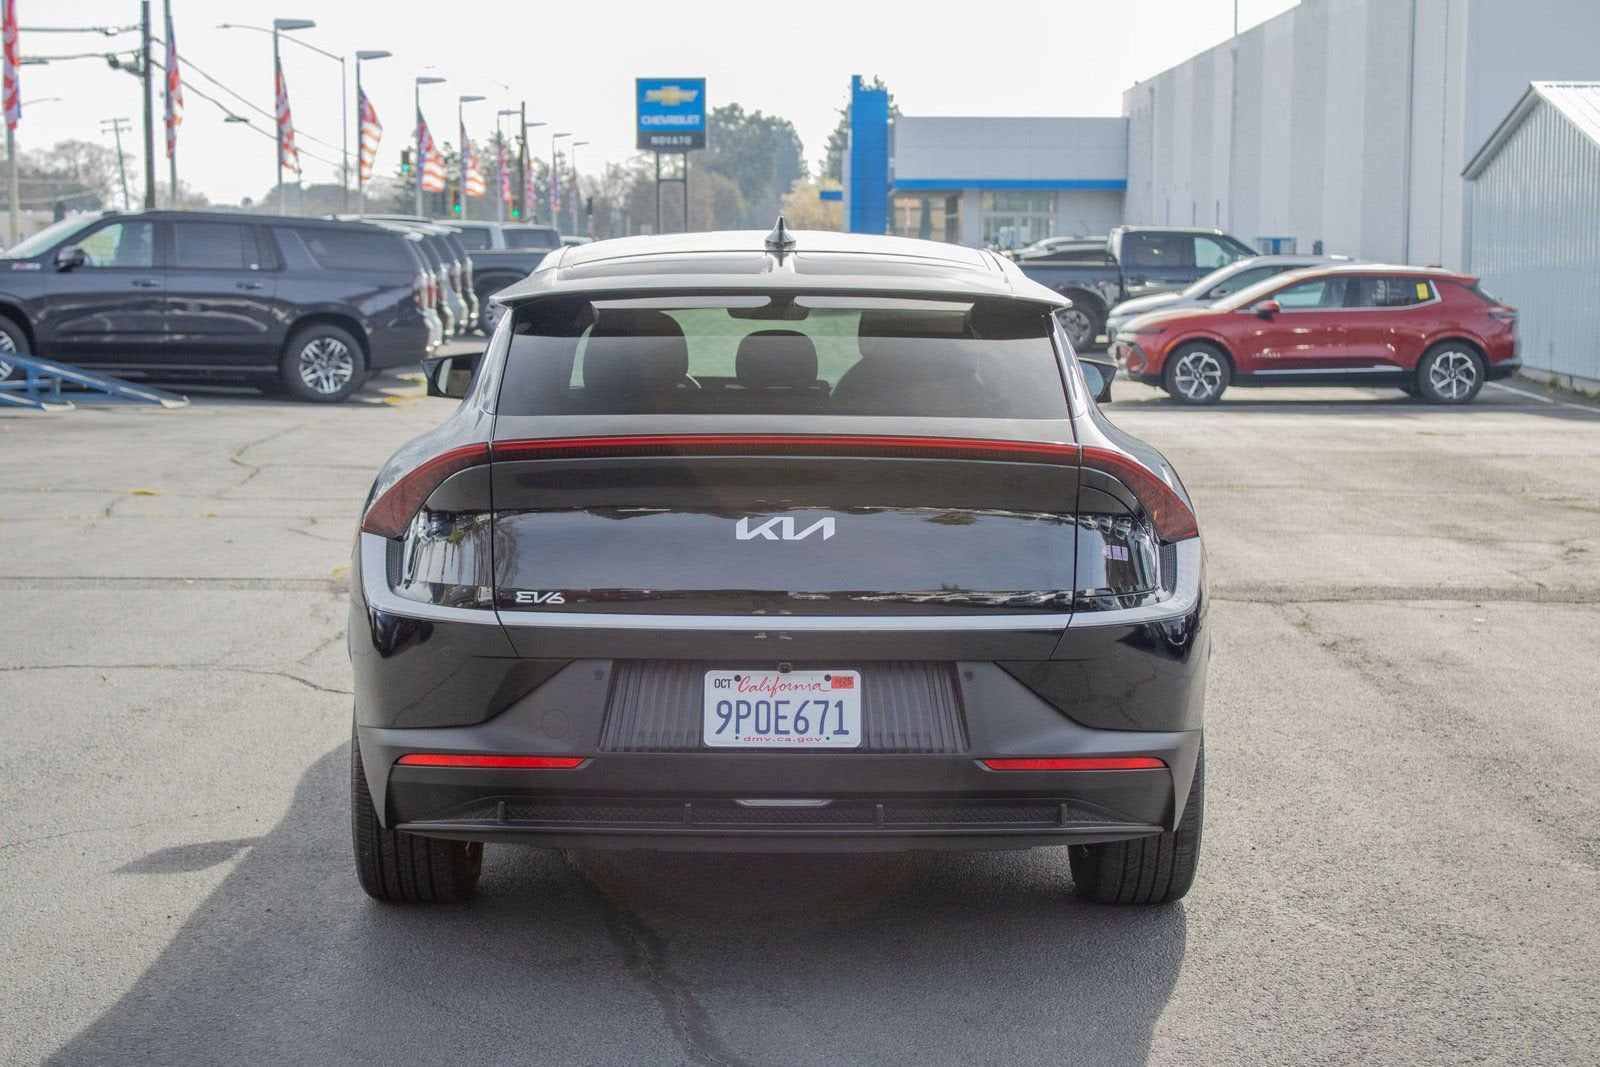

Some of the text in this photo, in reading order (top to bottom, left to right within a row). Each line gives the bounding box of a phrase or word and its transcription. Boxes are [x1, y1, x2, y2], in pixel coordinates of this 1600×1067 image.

[736, 516, 835, 541] KIA
[515, 591, 565, 604] EV6
[714, 678, 732, 689] OCT
[737, 675, 831, 697] California
